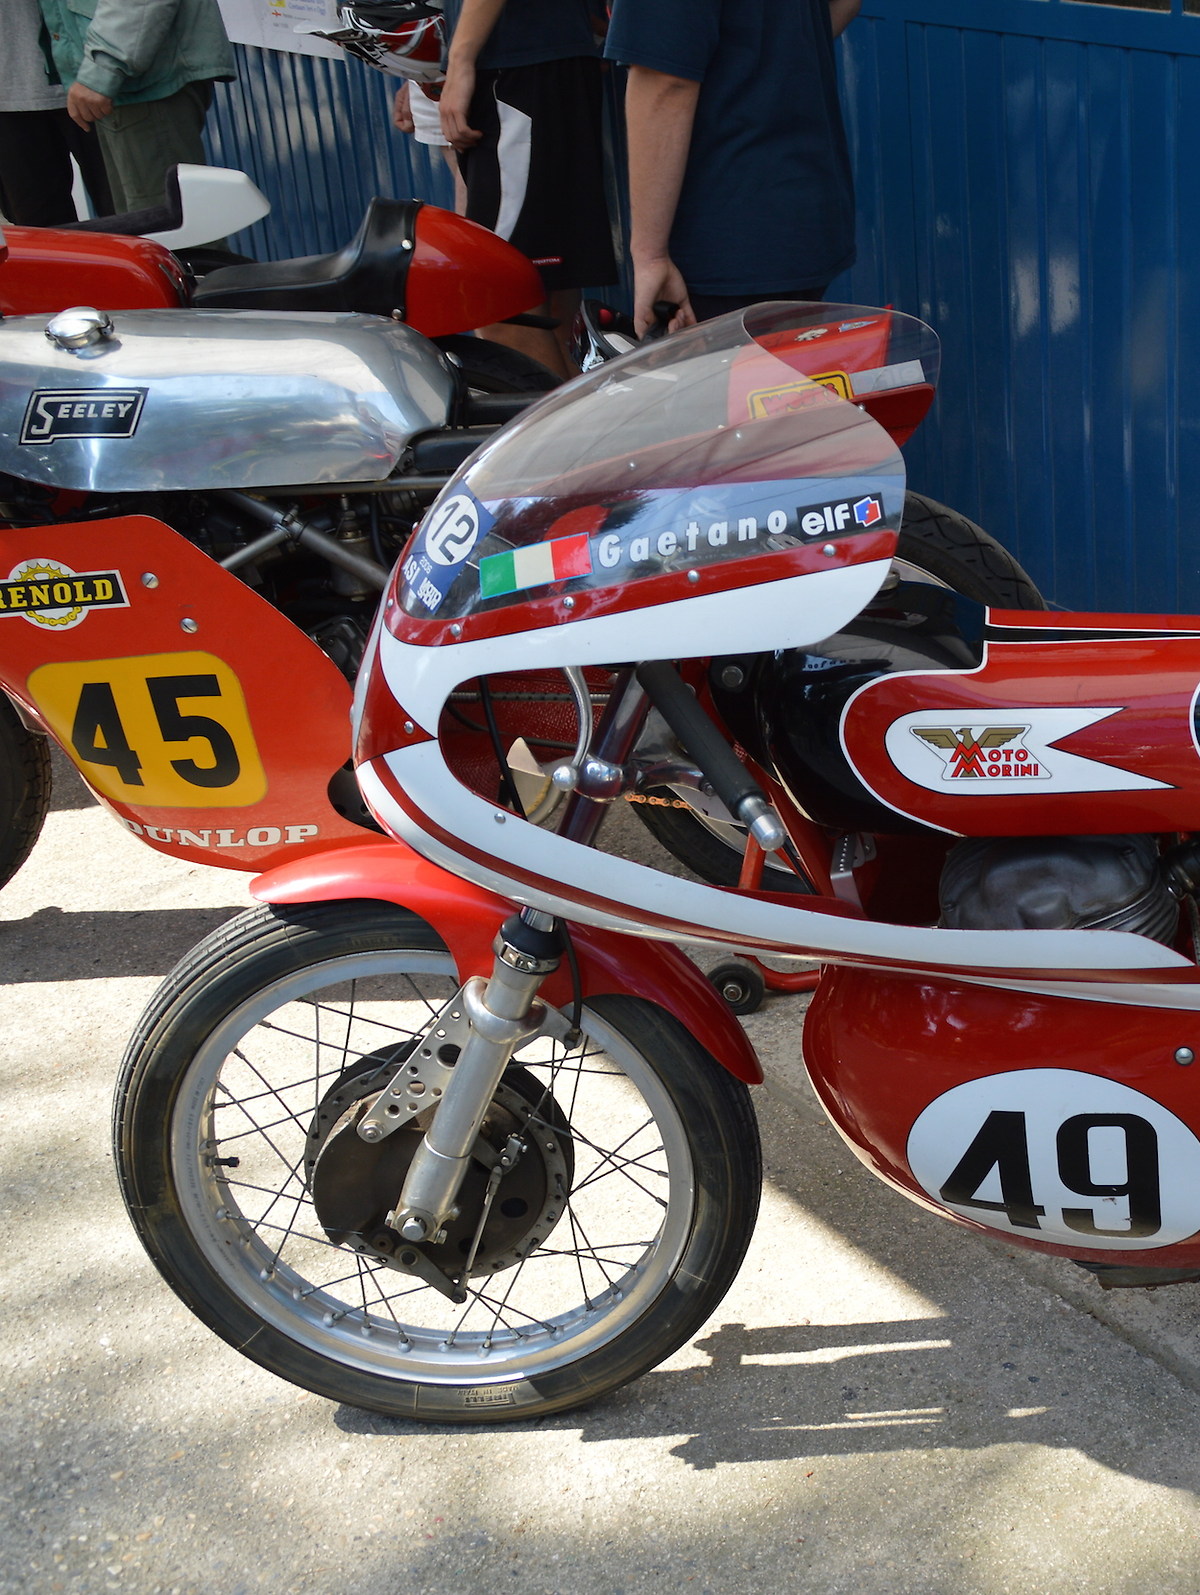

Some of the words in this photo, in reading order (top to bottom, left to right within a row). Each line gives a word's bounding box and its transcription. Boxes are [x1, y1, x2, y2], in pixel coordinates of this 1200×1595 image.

[31, 396, 135, 435] SEELEY
[431, 501, 475, 563] 12
[801, 503, 850, 536] elf
[598, 510, 788, 568] Gaetano
[402, 554, 421, 585] ASI
[71, 674, 241, 788] 45
[950, 741, 1028, 763] MOTO
[951, 757, 1039, 778] MORINI
[122, 824, 319, 848] DUNLOP
[938, 1110, 1162, 1239] 49
